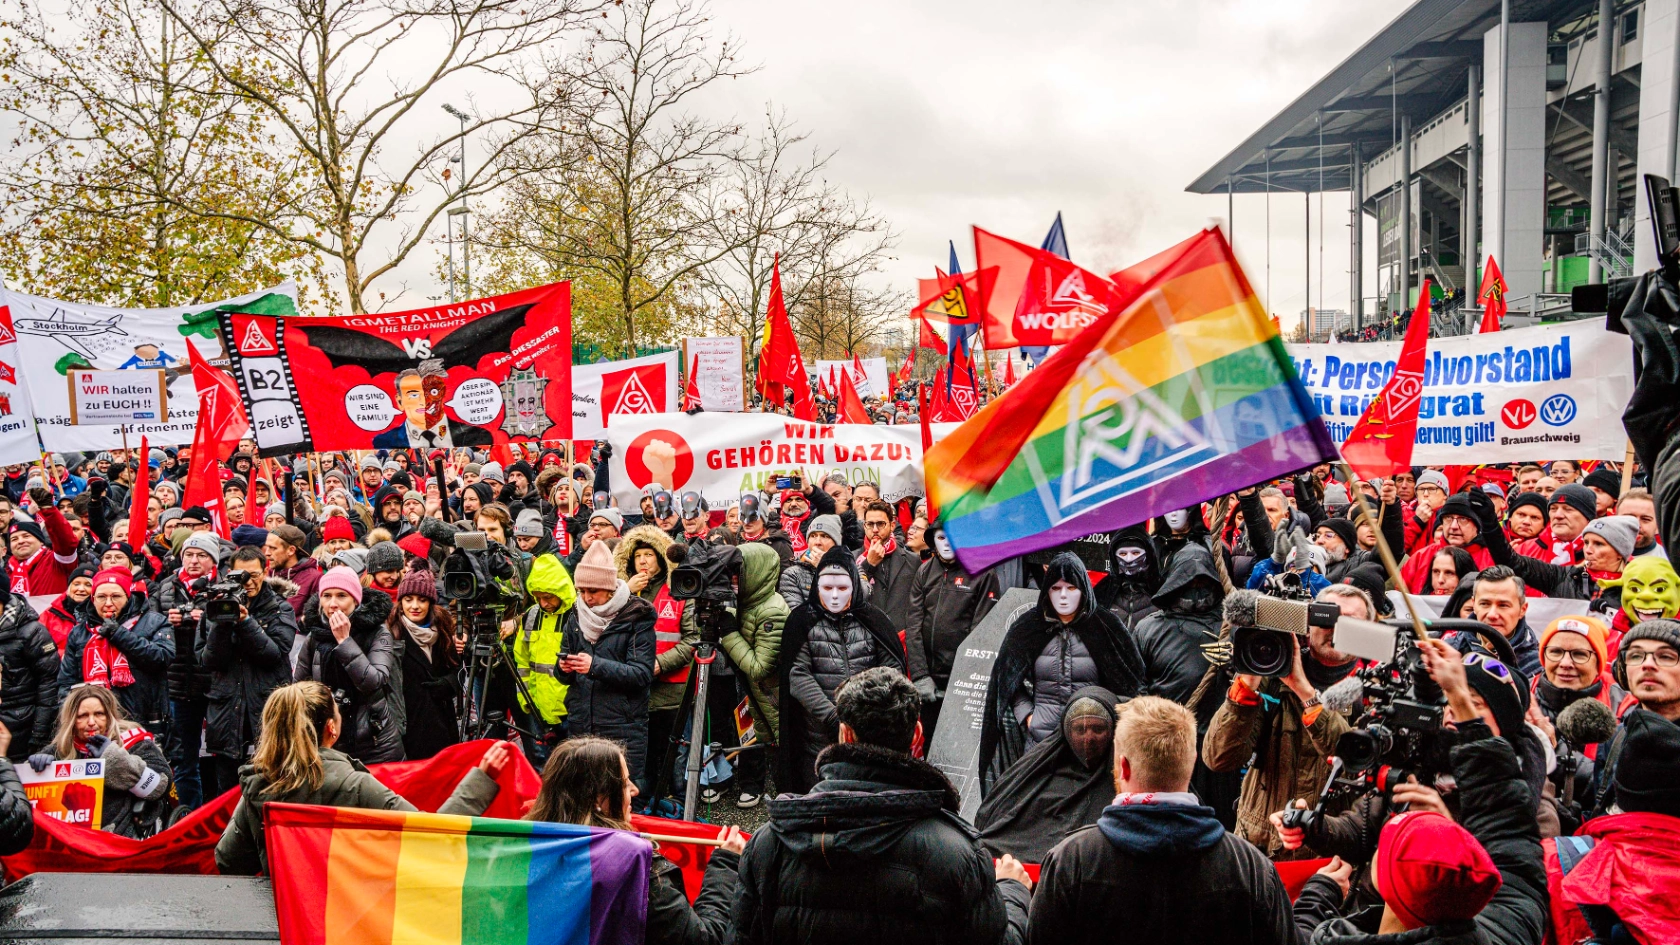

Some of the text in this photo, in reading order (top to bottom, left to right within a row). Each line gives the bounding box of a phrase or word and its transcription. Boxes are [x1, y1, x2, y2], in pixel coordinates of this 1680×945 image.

[343, 300, 497, 327] IGMETALLMAN
[33, 321, 88, 331] Stockholm
[379, 317, 466, 333] THE RED KNIGHTS
[494, 354, 512, 367] Das
[249, 369, 284, 391] B2
[82, 384, 152, 395] WIR halten
[365, 392, 385, 400] SIND
[85, 402, 100, 410] zu
[103, 399, 141, 409] EUCH
[360, 403, 380, 411] EINE
[470, 406, 488, 414] WERT
[258, 413, 295, 430] zeigt
[356, 413, 389, 422] FAMILIE
[113, 423, 135, 435] auf
[137, 423, 179, 434] denen
[1465, 421, 1495, 446] gilt!
[1501, 432, 1581, 446] Braunschweig
[706, 439, 913, 471] GEHÖREN DAZU!
[964, 648, 994, 660] ERST
[973, 682, 987, 691] die
